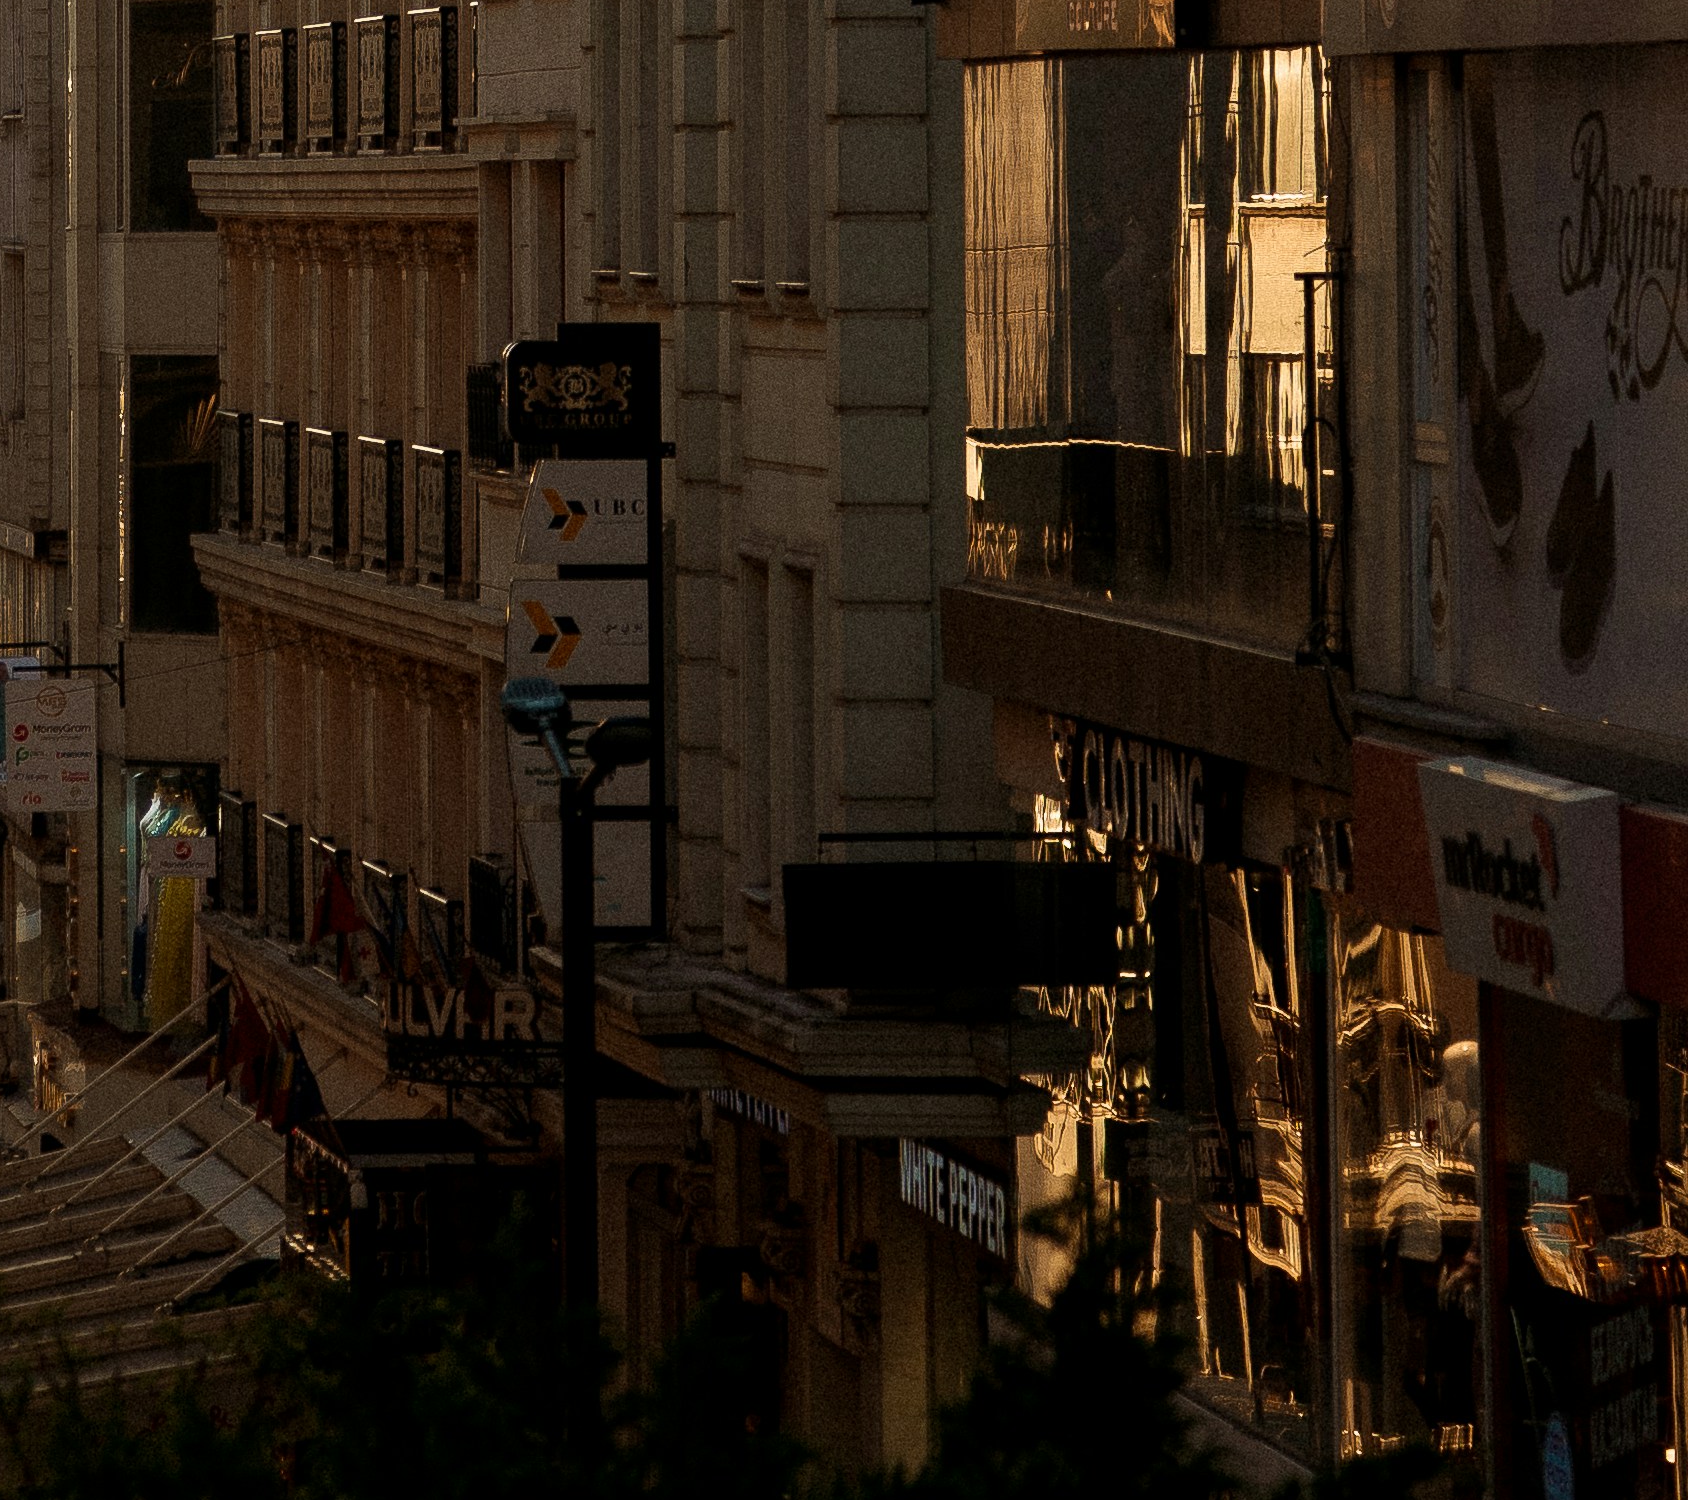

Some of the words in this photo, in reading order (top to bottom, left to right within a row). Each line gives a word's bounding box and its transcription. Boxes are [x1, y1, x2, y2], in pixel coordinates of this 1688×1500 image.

[593, 498, 645, 516] UBC
[32, 723, 91, 735] MoneyGram
[1081, 727, 1207, 866] CLOTHING
[899, 1137, 946, 1225] WHITE
[948, 1158, 1007, 1261] PEPPER
